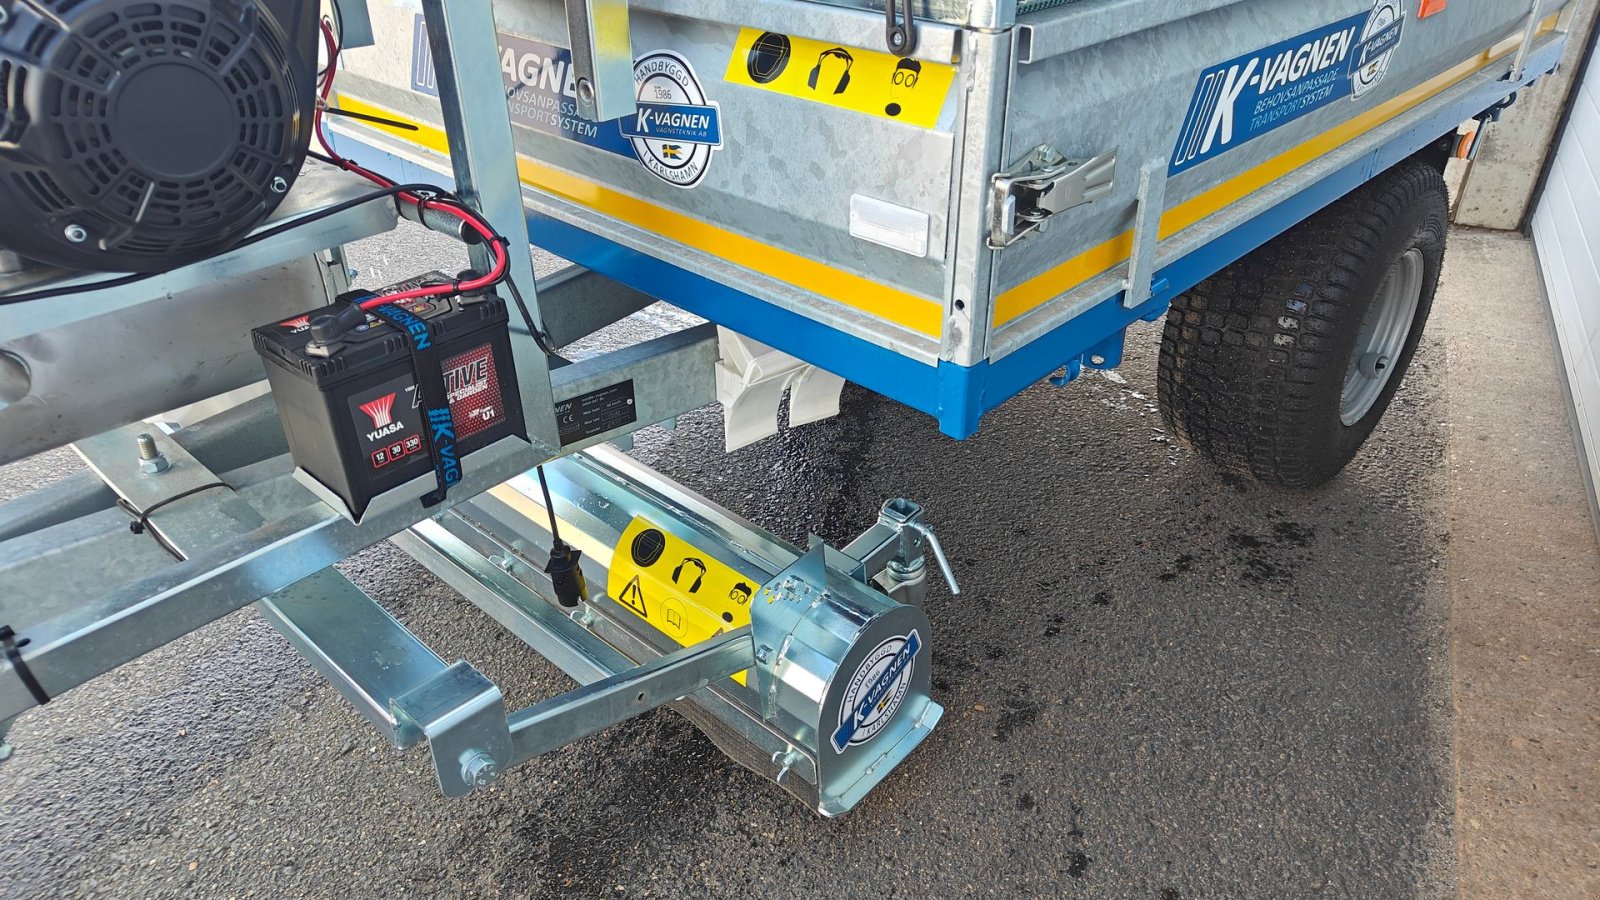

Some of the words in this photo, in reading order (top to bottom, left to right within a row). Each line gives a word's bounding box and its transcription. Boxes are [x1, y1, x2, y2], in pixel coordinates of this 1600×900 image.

[499, 47, 578, 99] AGNE
[634, 61, 690, 87] HANDBYGGD
[506, 86, 588, 120] OVSANPASSA
[654, 89, 672, 100] 1986
[1200, 26, 1356, 154] K-VAGNEN
[1254, 67, 1341, 115] BEHOVSANPASSADE
[508, 102, 598, 139] NSPORTSYSTEM
[636, 107, 710, 133] K-VAGNEN
[1250, 84, 1334, 132] TRANSPORTSYSTEM
[656, 127, 697, 136] VAGNSTEKNIK
[648, 162, 699, 181] KARLSHAMN
[412, 357, 489, 409] ATIVE
[457, 384, 488, 401] GARDEN
[482, 410, 495, 421] U1
[366, 421, 404, 442] YUASA
[405, 438, 419, 448] 330
[375, 452, 385, 461] 12
[391, 445, 401, 454] 30
[431, 423, 462, 488] K-VAG
[847, 644, 892, 703] HANDBYGGD
[853, 644, 911, 730] K-VAGNEN
[866, 682, 907, 735] KARLSHAMN
